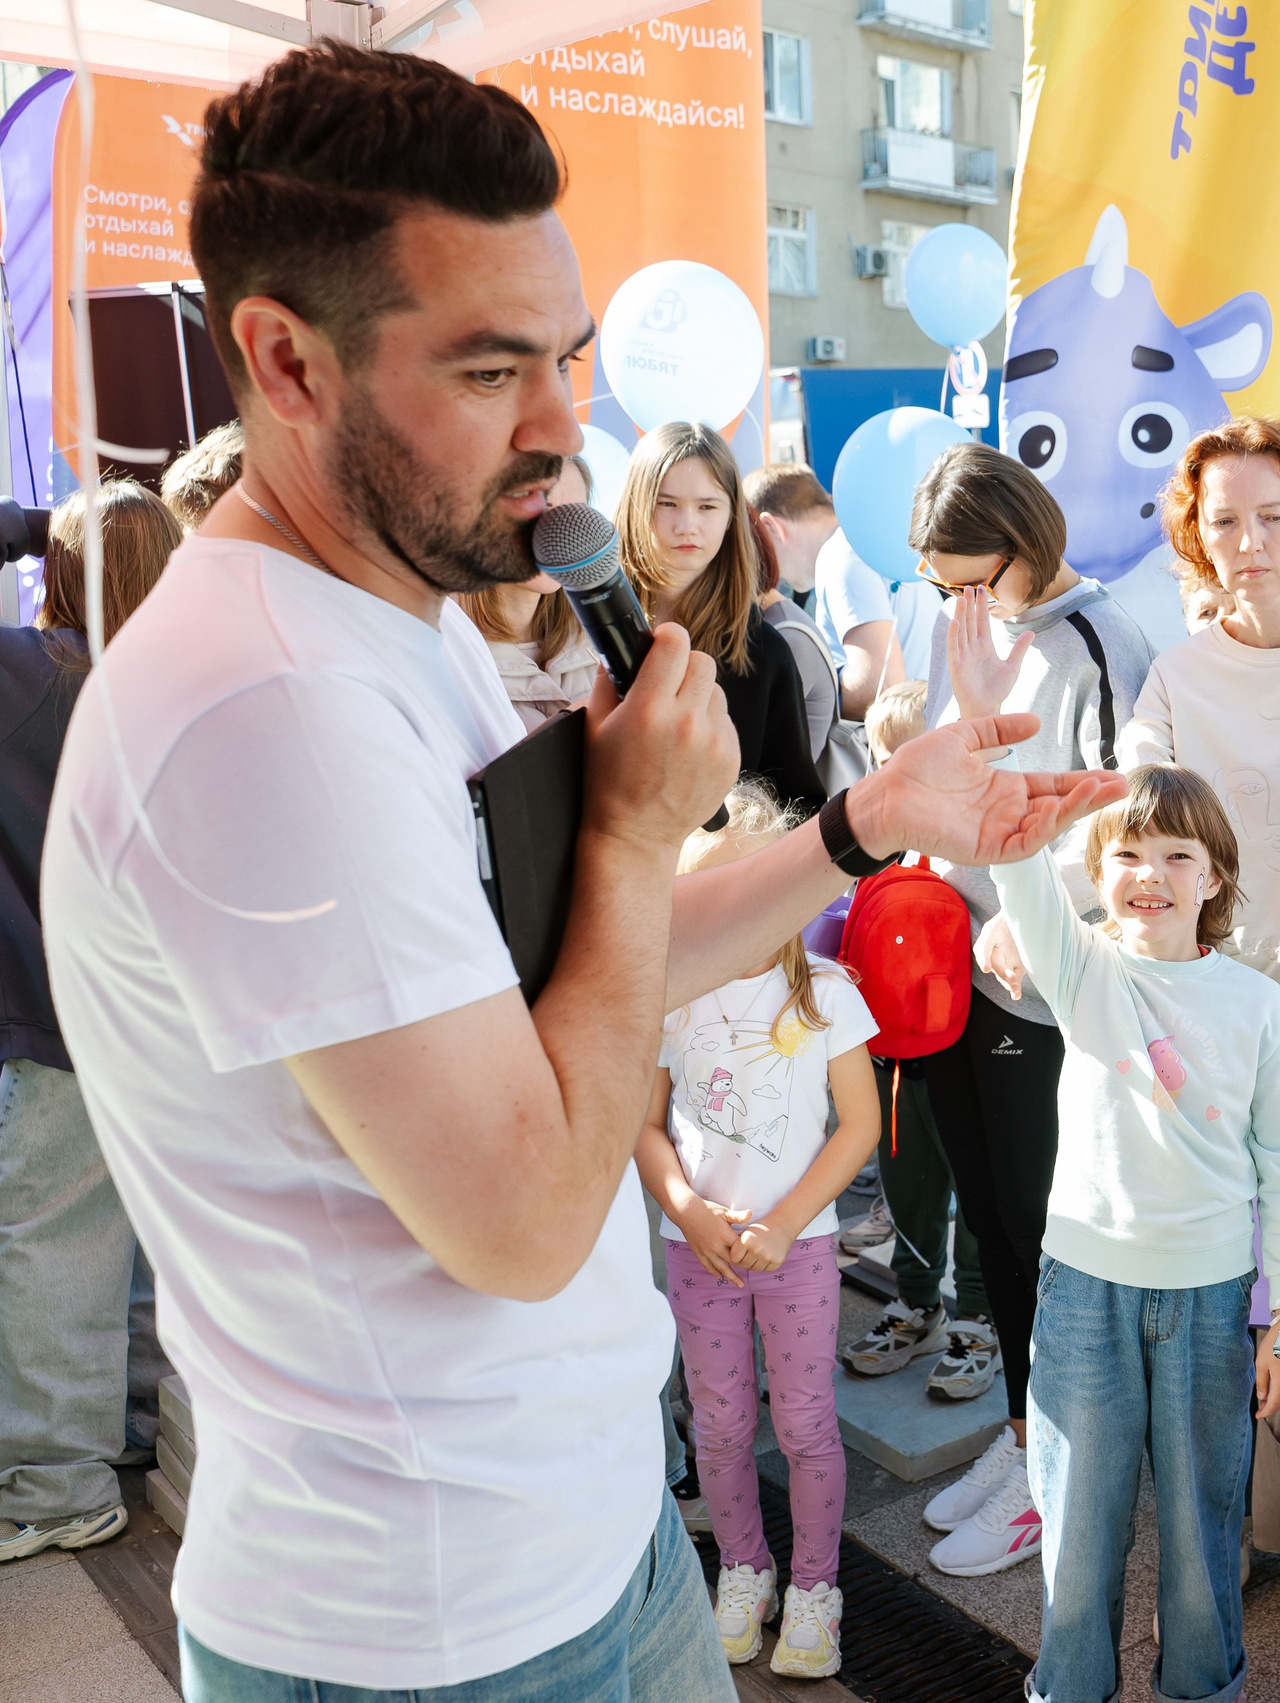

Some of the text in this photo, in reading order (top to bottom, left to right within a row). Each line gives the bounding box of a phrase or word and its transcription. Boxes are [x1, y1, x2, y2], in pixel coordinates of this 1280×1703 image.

[648, 18, 752, 59] слушай,
[1171, 0, 1216, 160] ТРИ
[520, 84, 746, 130] и наслаждайся!
[84, 184, 172, 215] Смотри,
[84, 213, 174, 237] отдыхай
[103, 240, 196, 269] наслажд
